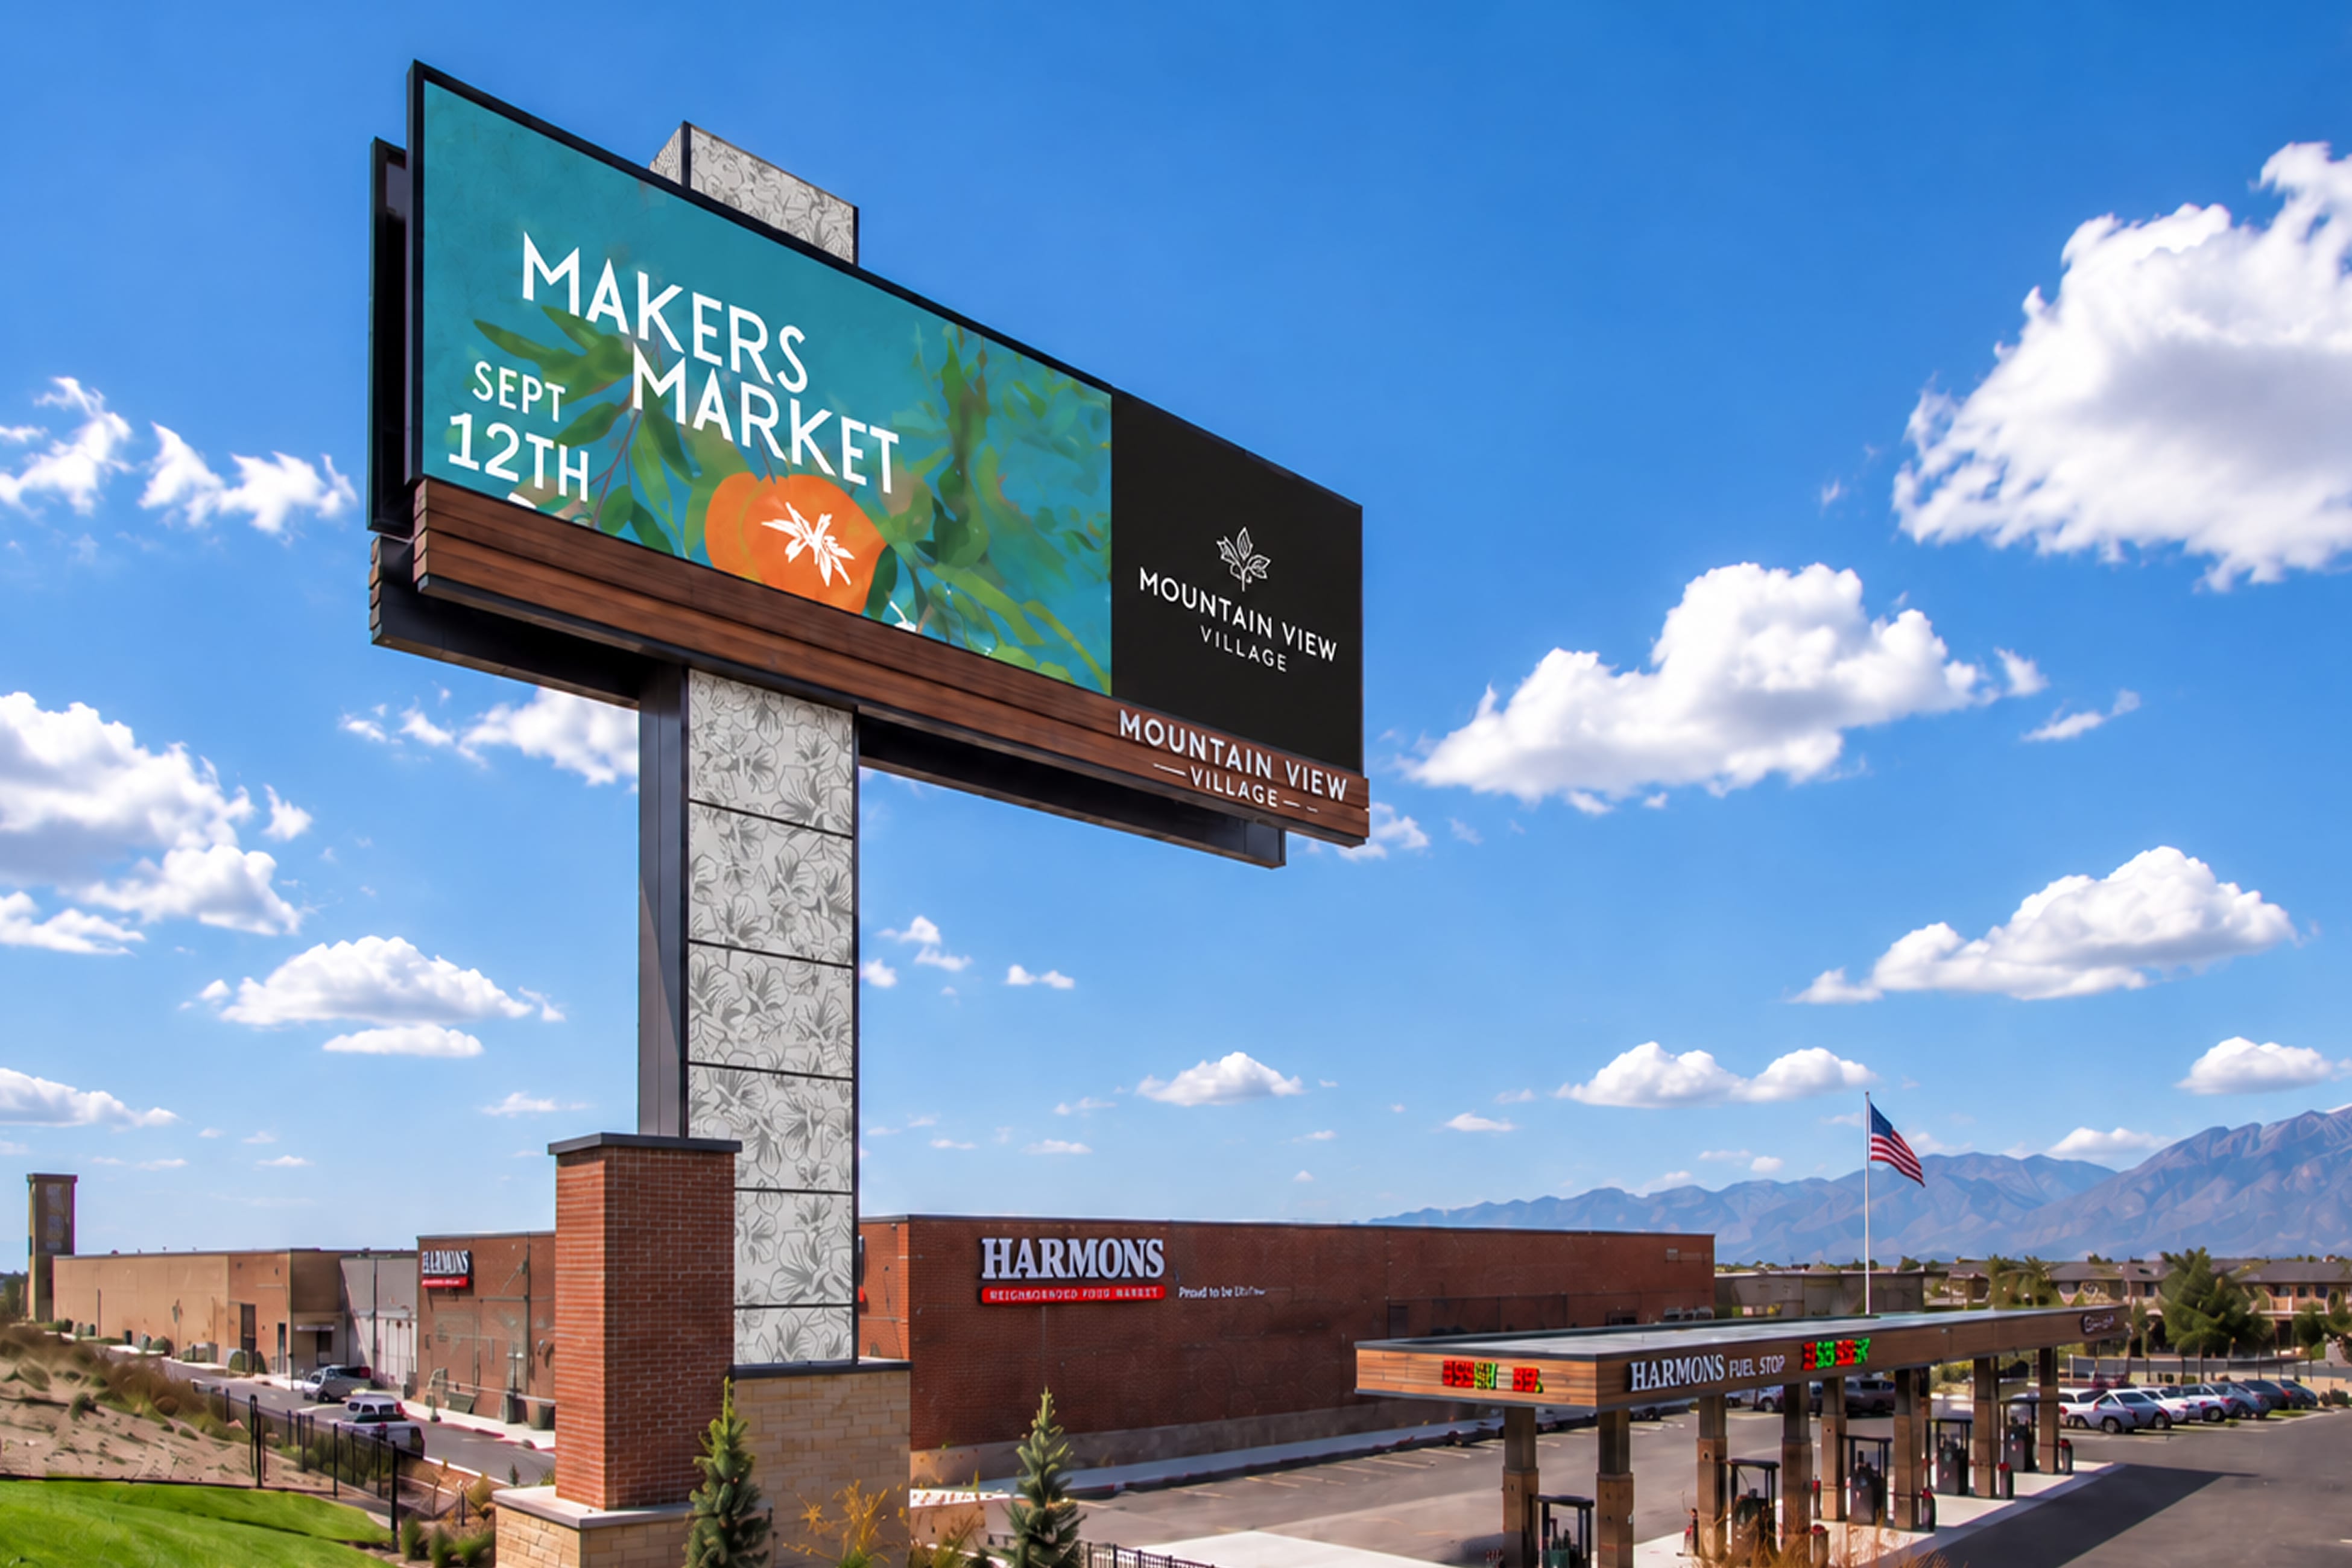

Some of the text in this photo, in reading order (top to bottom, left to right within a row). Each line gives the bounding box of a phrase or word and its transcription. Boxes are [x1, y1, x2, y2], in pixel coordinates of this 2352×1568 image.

[522, 231, 808, 393] MAKERS
[472, 361, 566, 422] SEPT
[633, 343, 899, 495] MARKET
[448, 413, 589, 502] 12TH
[1139, 566, 1337, 662] MOUNTAIN VIEW
[1200, 625, 1287, 672] VILLAGE
[1119, 709, 1347, 801] MOUNTAIN VIEW
[1190, 765, 1278, 808] VILLAGE
[981, 1238, 1165, 1279] HARMONS
[1630, 1354, 1785, 1392] HARMONS FUEL STOP
